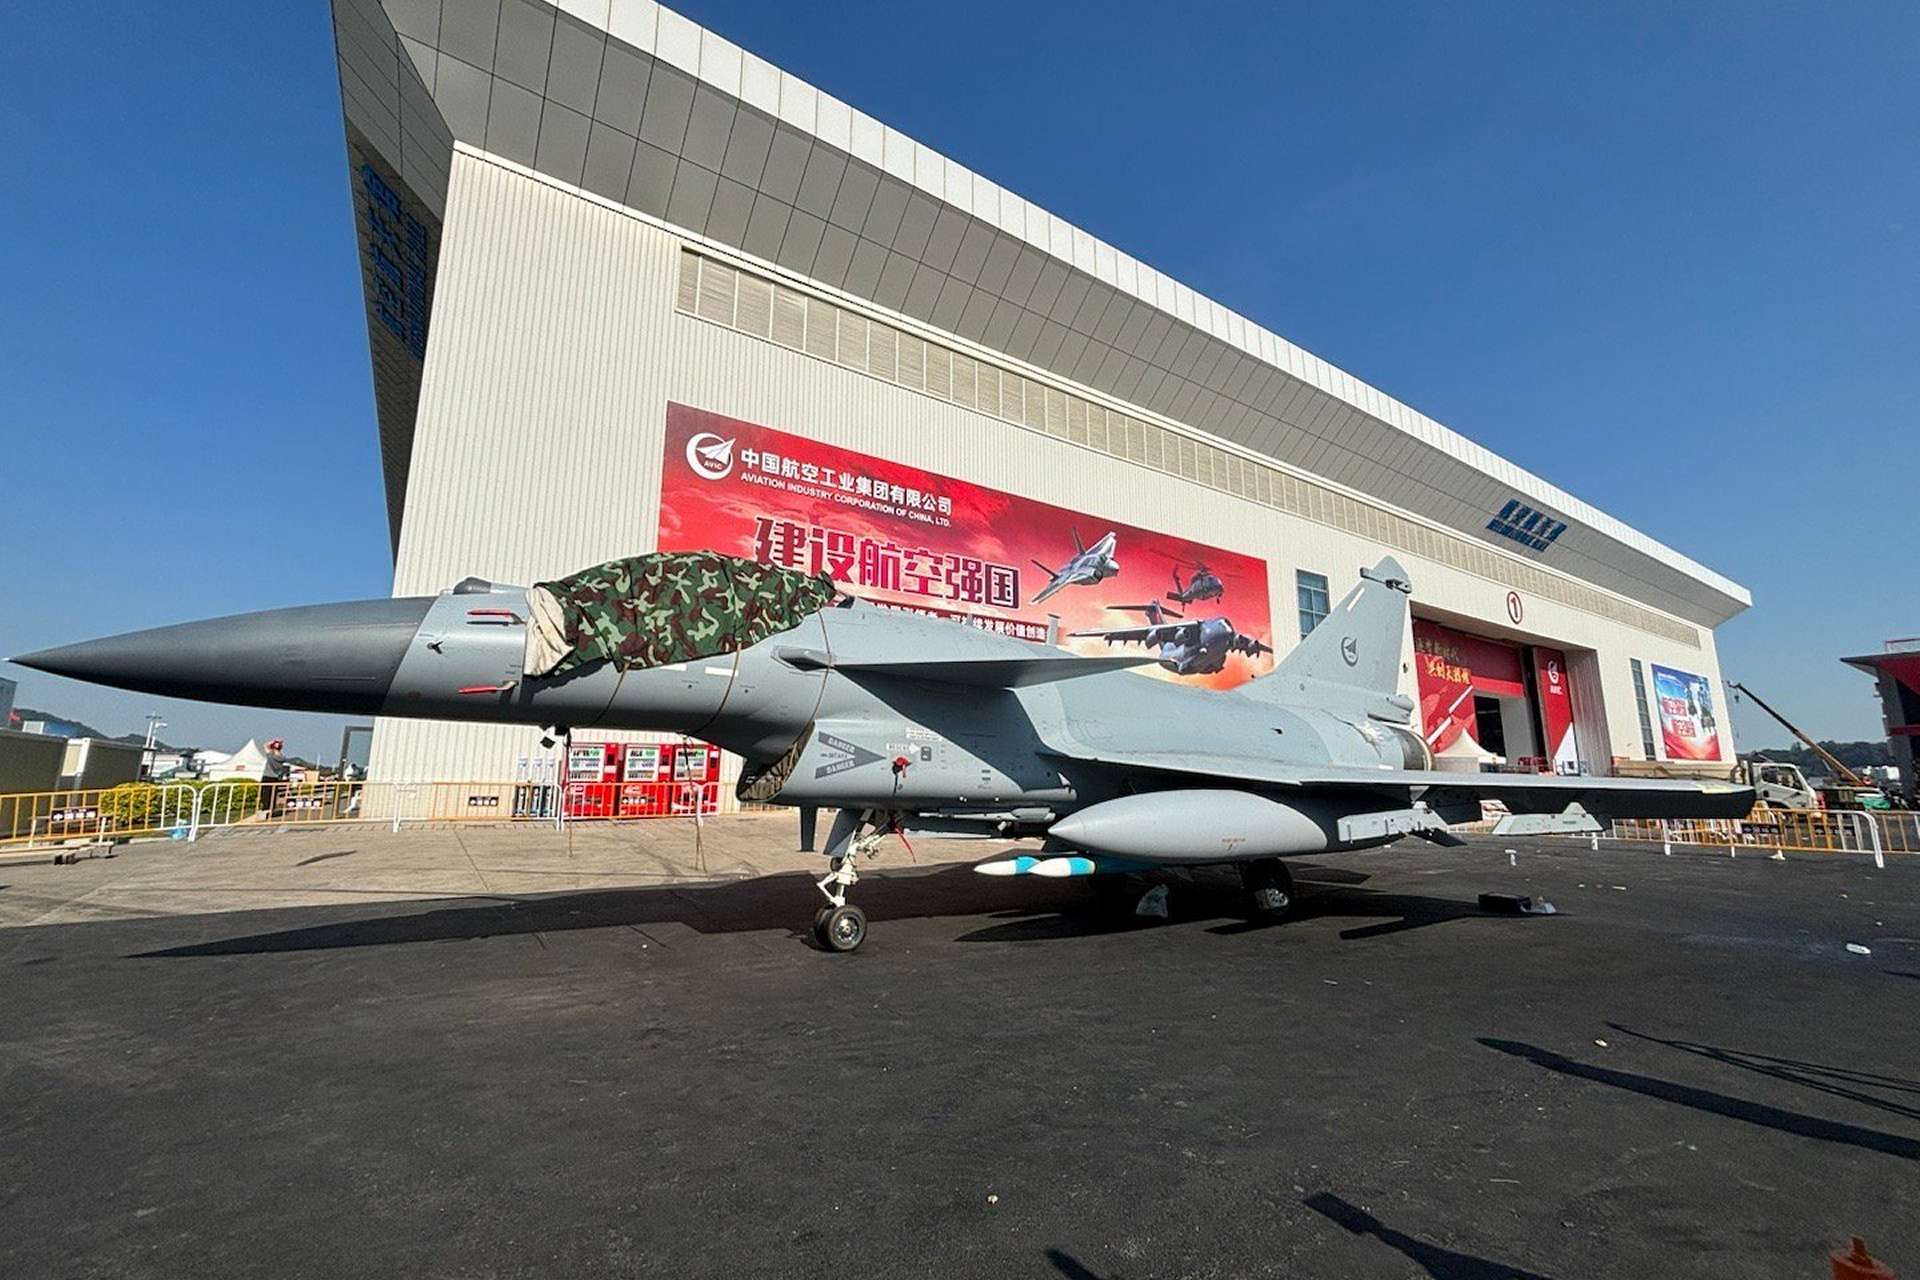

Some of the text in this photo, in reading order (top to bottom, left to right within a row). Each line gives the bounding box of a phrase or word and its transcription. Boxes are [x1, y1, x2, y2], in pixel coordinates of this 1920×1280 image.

[704, 459, 724, 470] AVIC
[741, 448, 952, 515] 中国航空工业集团有限公司
[741, 472, 952, 528] AVIATION INDUSTRY CORPORATION OF CHINA, LTD.
[756, 516, 1019, 610] 建设航空强国
[826, 760, 856, 775] DANGER
